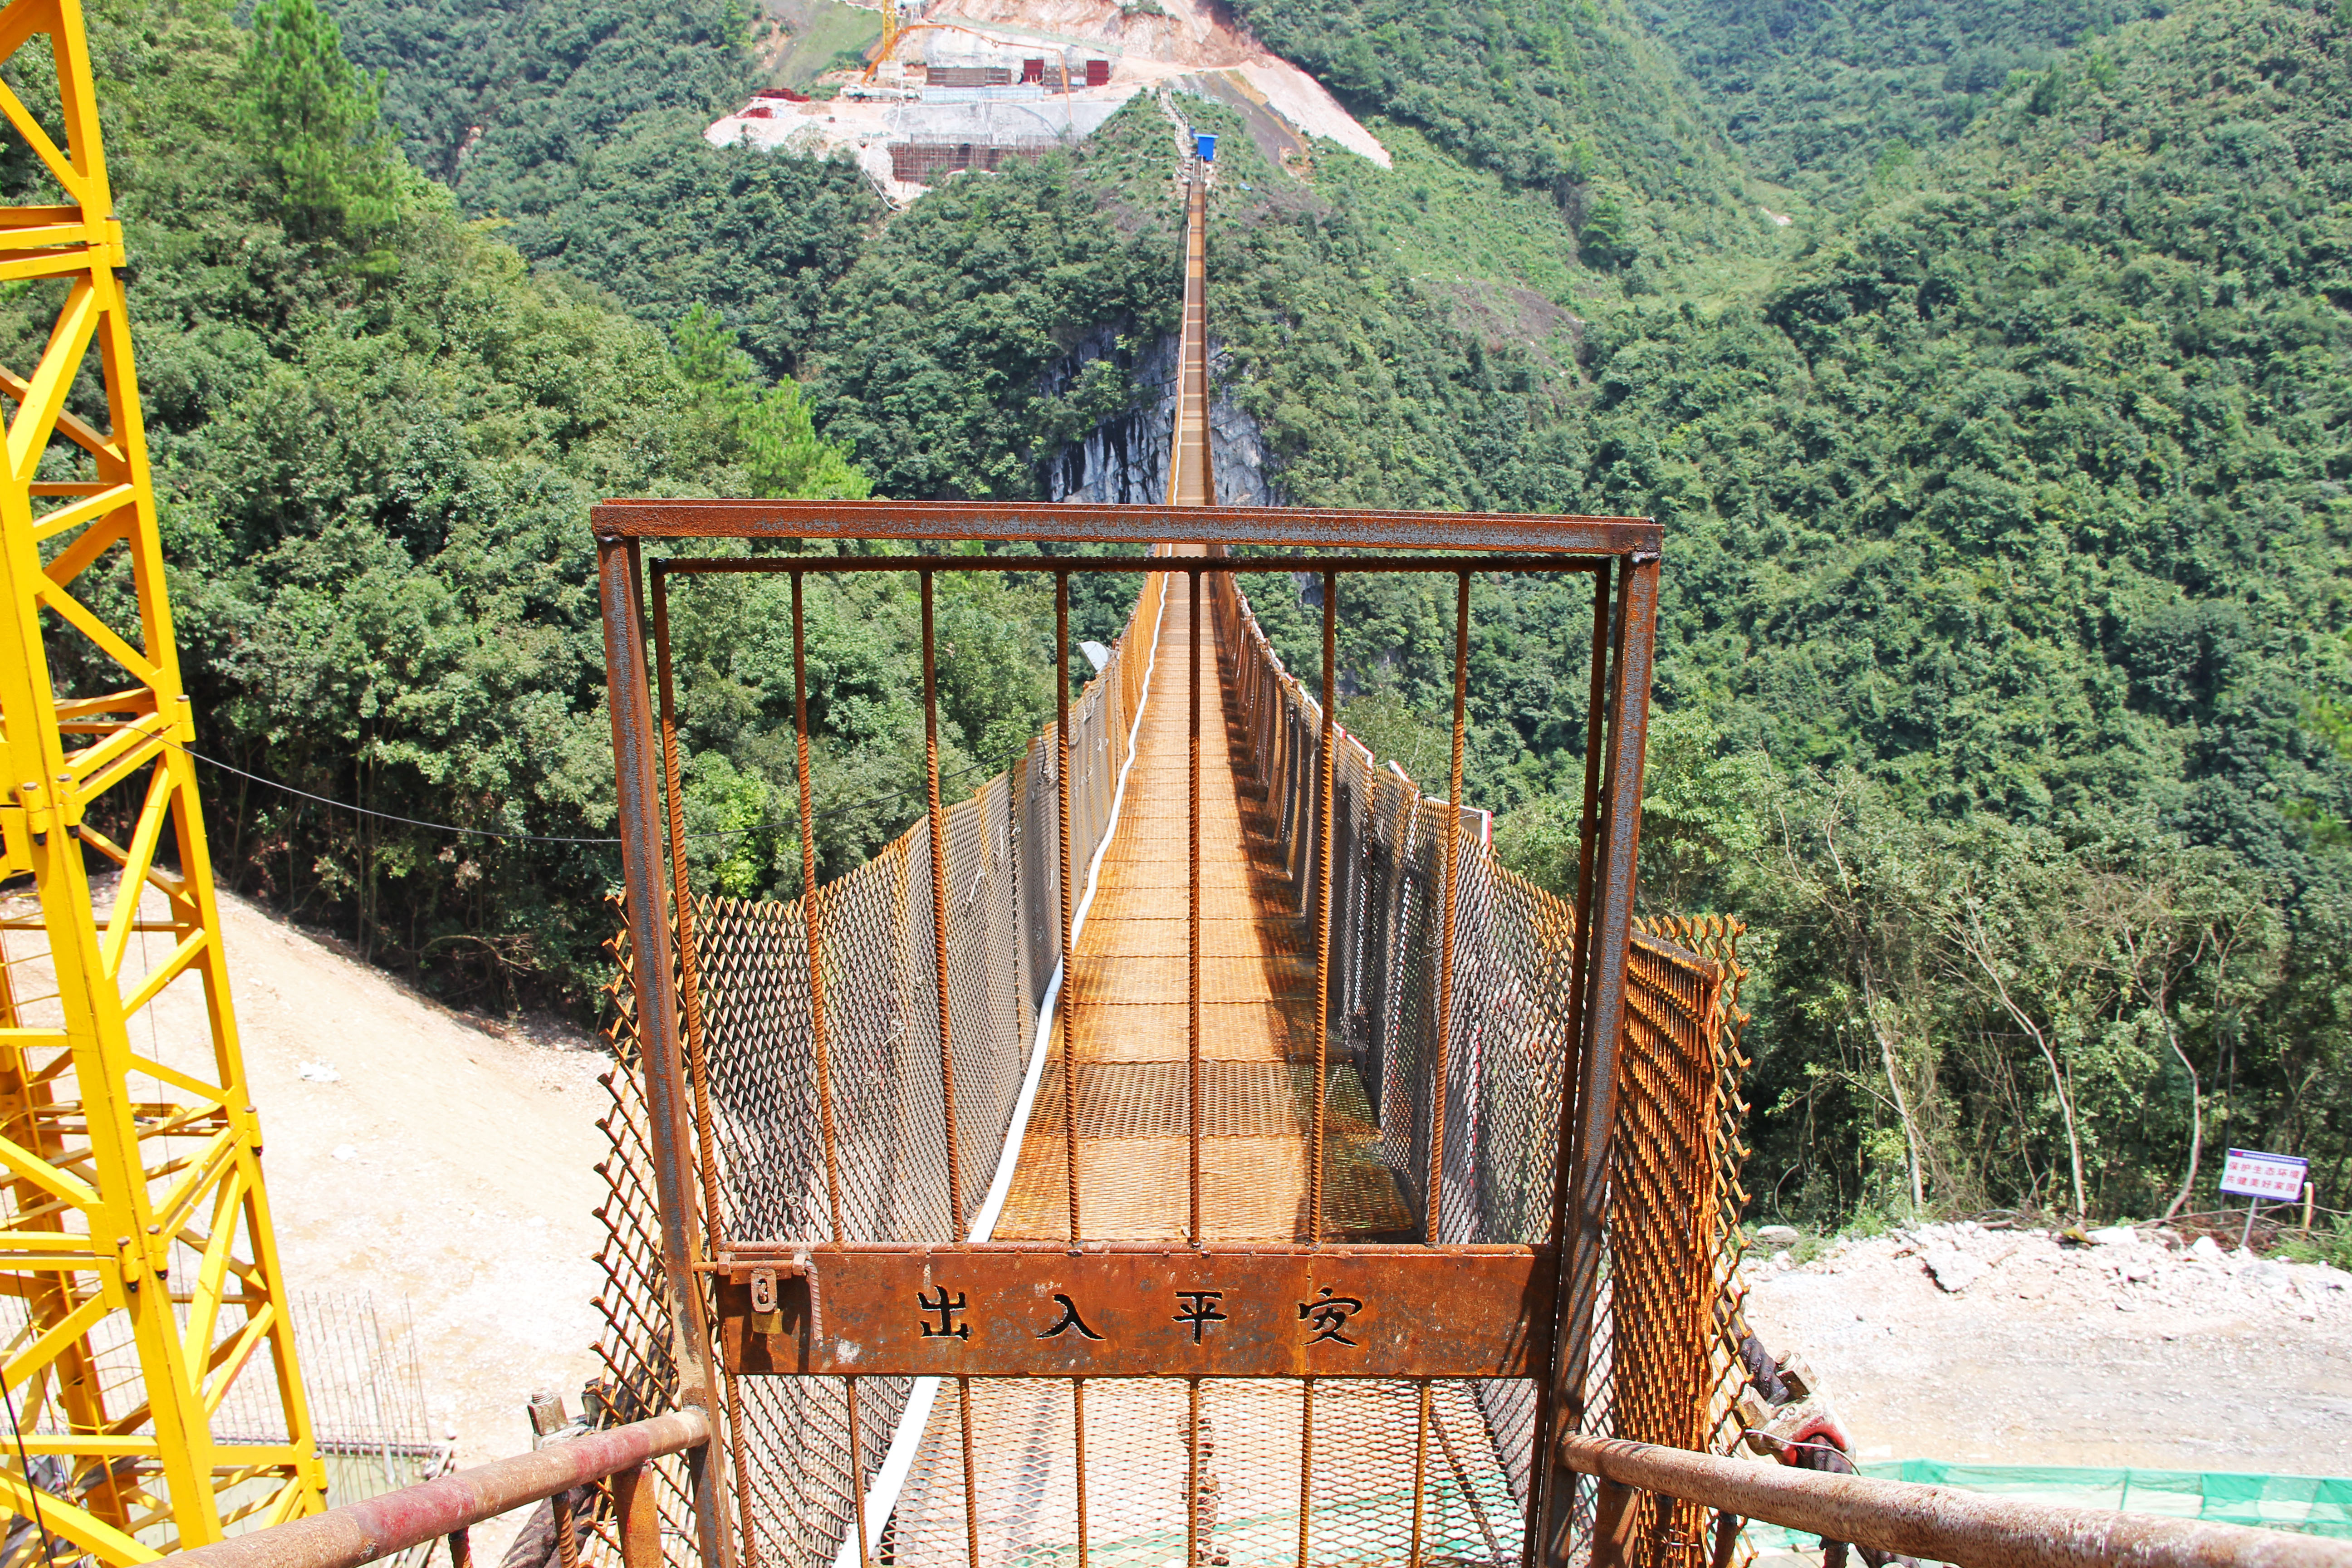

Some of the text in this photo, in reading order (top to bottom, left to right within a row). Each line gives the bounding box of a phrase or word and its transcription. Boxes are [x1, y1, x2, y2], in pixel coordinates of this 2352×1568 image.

[2228, 1161, 2300, 1179] 保护生态环境
[918, 1285, 1363, 1347] 出入平安
